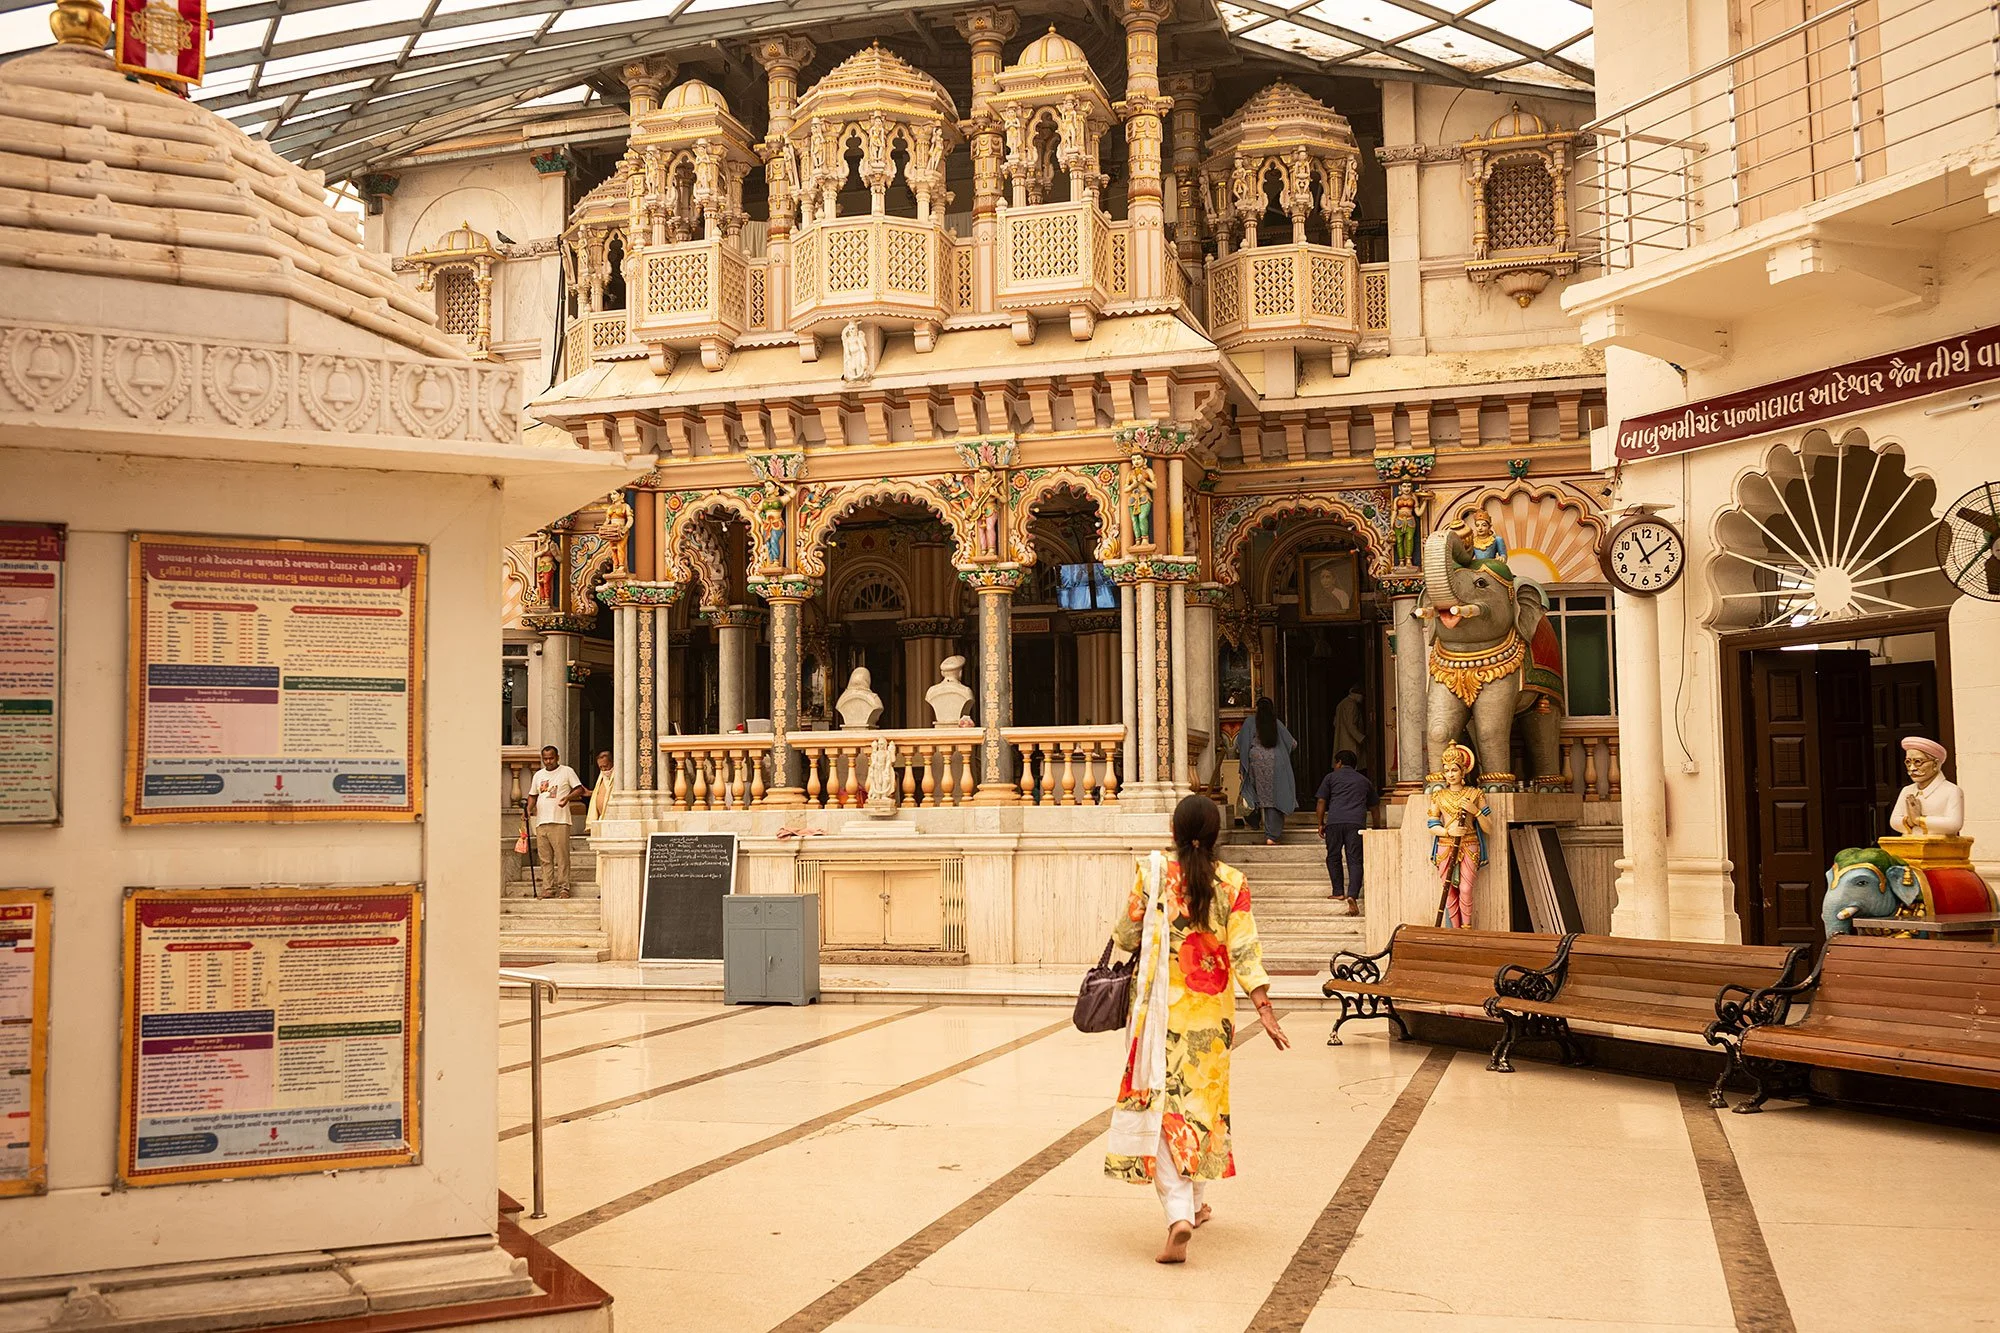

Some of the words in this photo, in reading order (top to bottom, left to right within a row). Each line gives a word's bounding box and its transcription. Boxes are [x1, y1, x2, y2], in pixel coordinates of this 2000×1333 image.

[1723, 388, 1805, 429] પન્નાલાલ
[1888, 357, 1922, 388] જૈન
[1926, 339, 1970, 381] તીર્થ
[1641, 528, 1652, 539] 12
[1621, 541, 1630, 551] 10
[1617, 552, 1624, 562] 9
[1668, 552, 1675, 562] 3
[1620, 564, 1628, 574] 8
[1663, 565, 1670, 574] 4
[1629, 573, 1637, 583] 7
[1641, 576, 1649, 586] 6
[1654, 573, 1662, 582] 5
